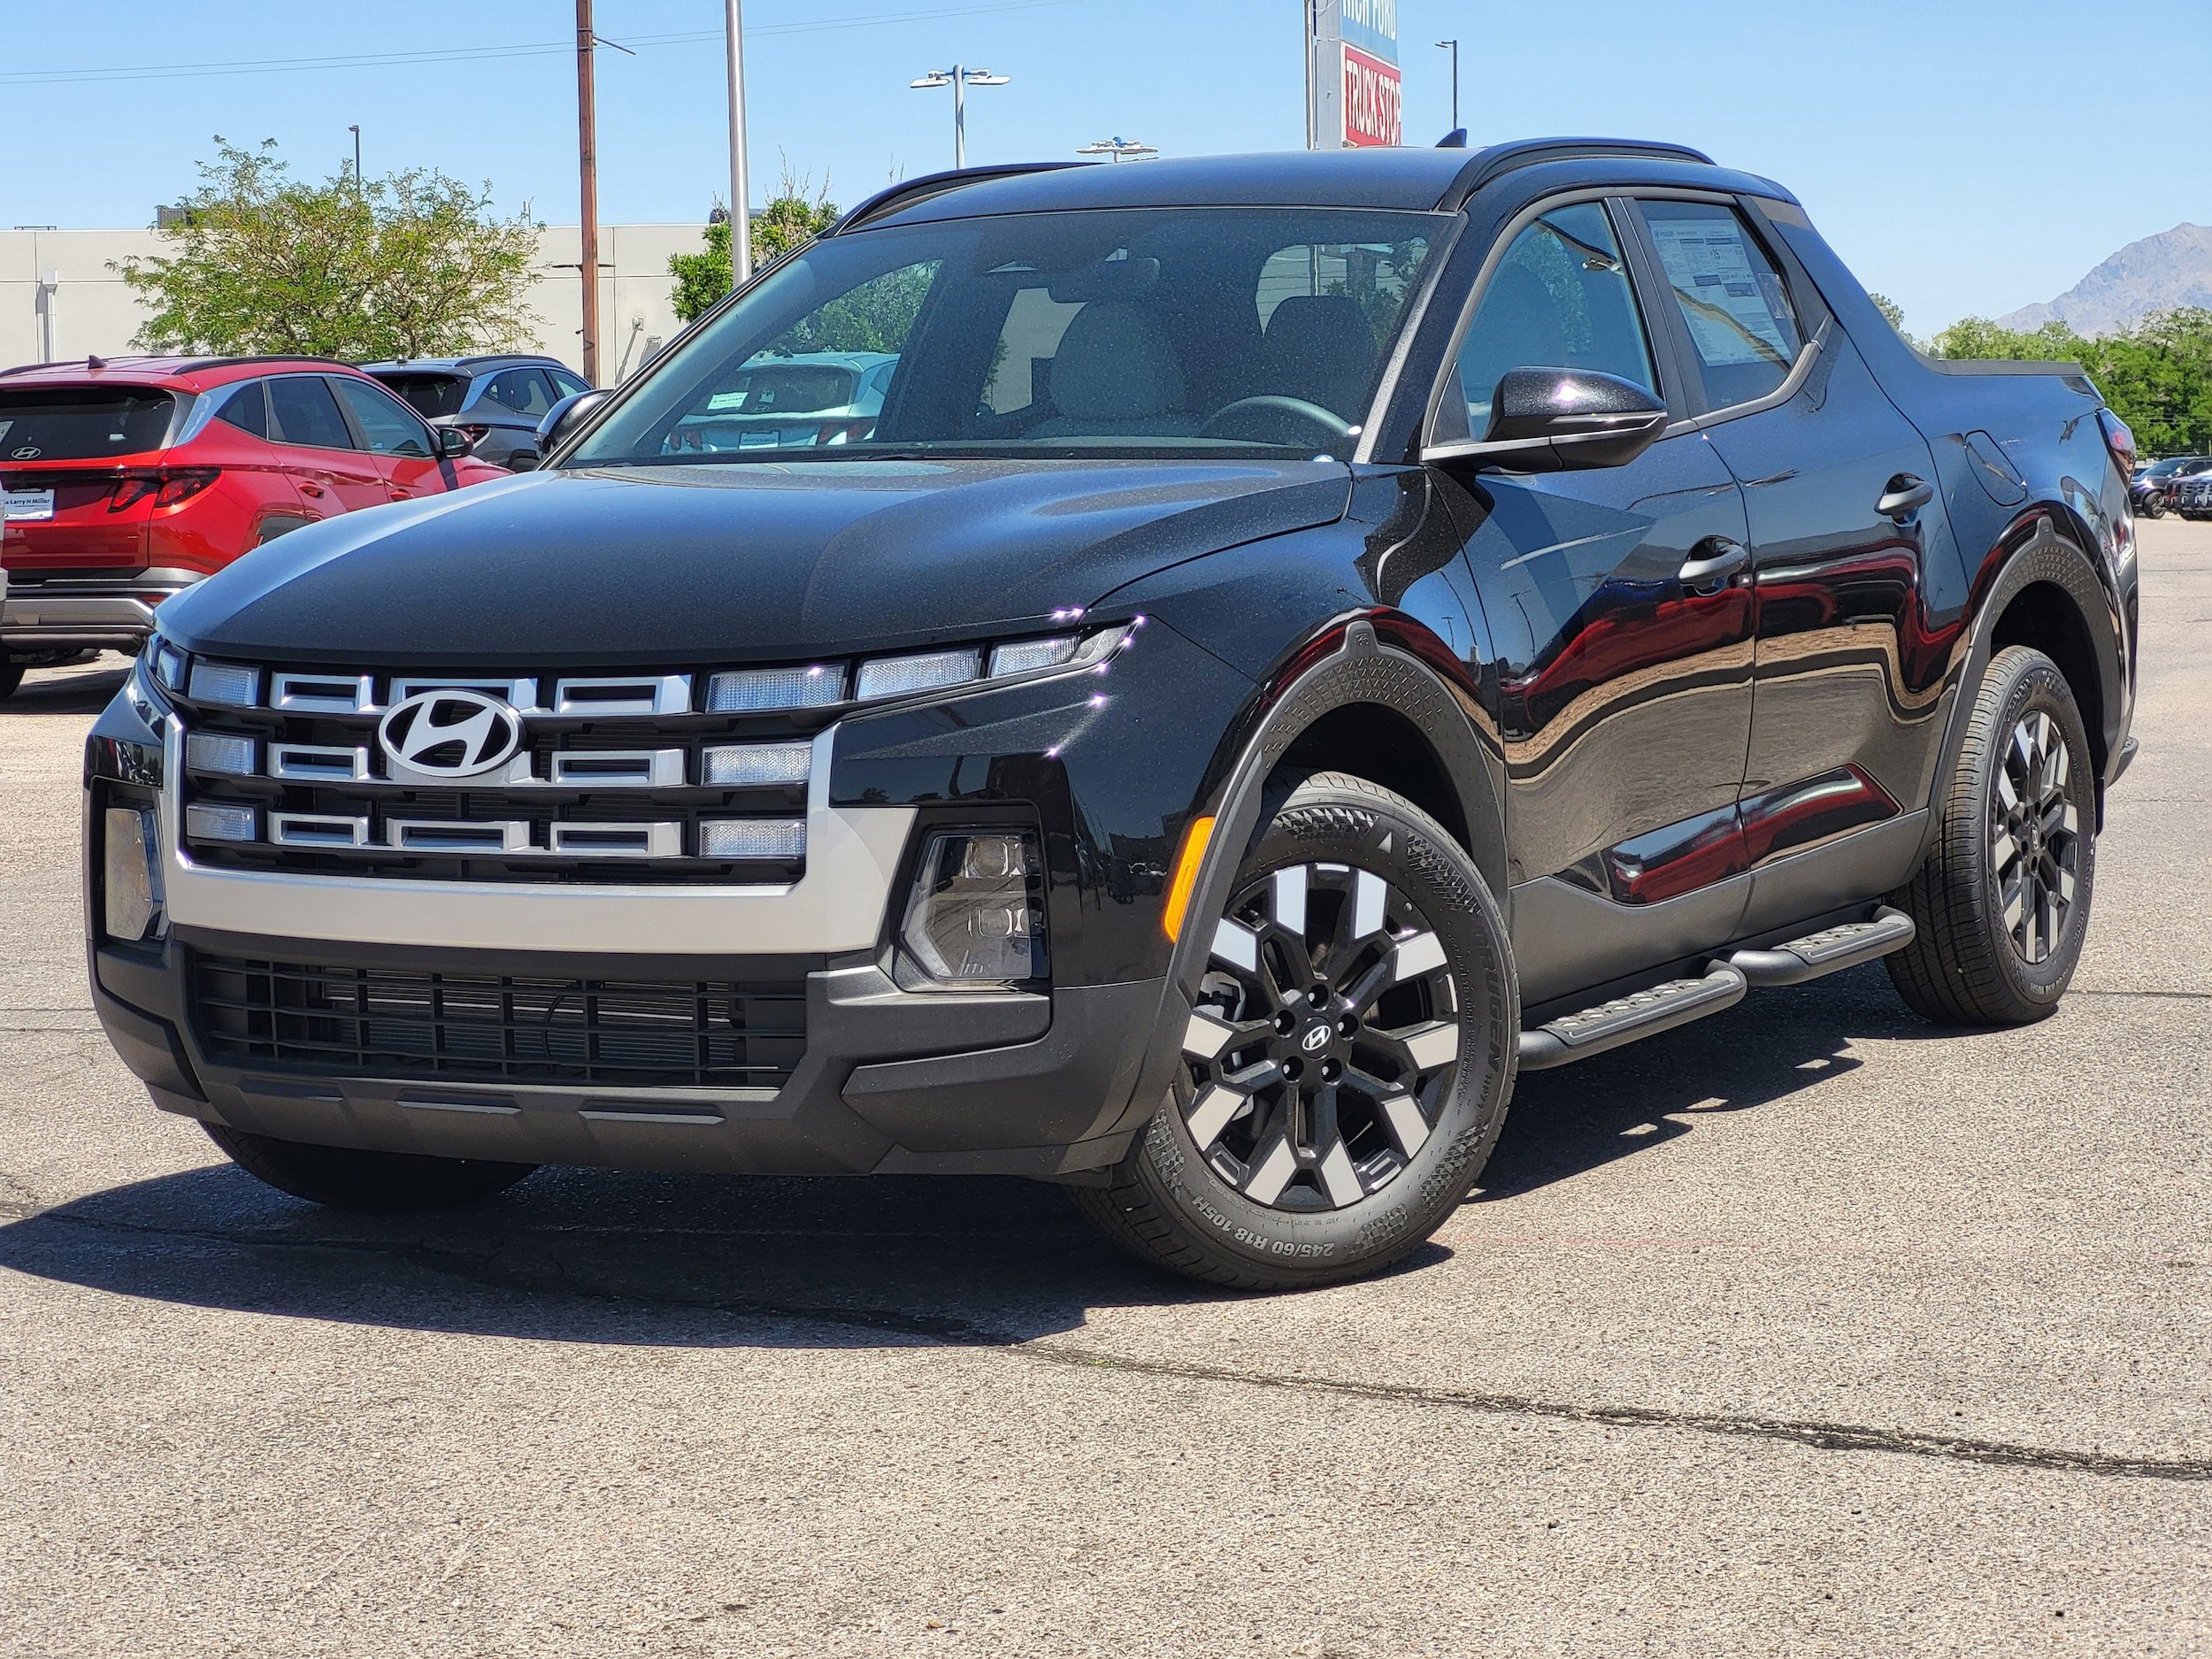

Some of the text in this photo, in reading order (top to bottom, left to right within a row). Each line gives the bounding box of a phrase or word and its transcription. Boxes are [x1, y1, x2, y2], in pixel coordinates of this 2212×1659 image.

[1372, 0, 1396, 41] FORD
[1346, 58, 1402, 146] TRUCK STOP
[1191, 1194, 1233, 1233] 105H
[1233, 1226, 1269, 1250] R18
[1271, 1240, 1335, 1258] 245/60
